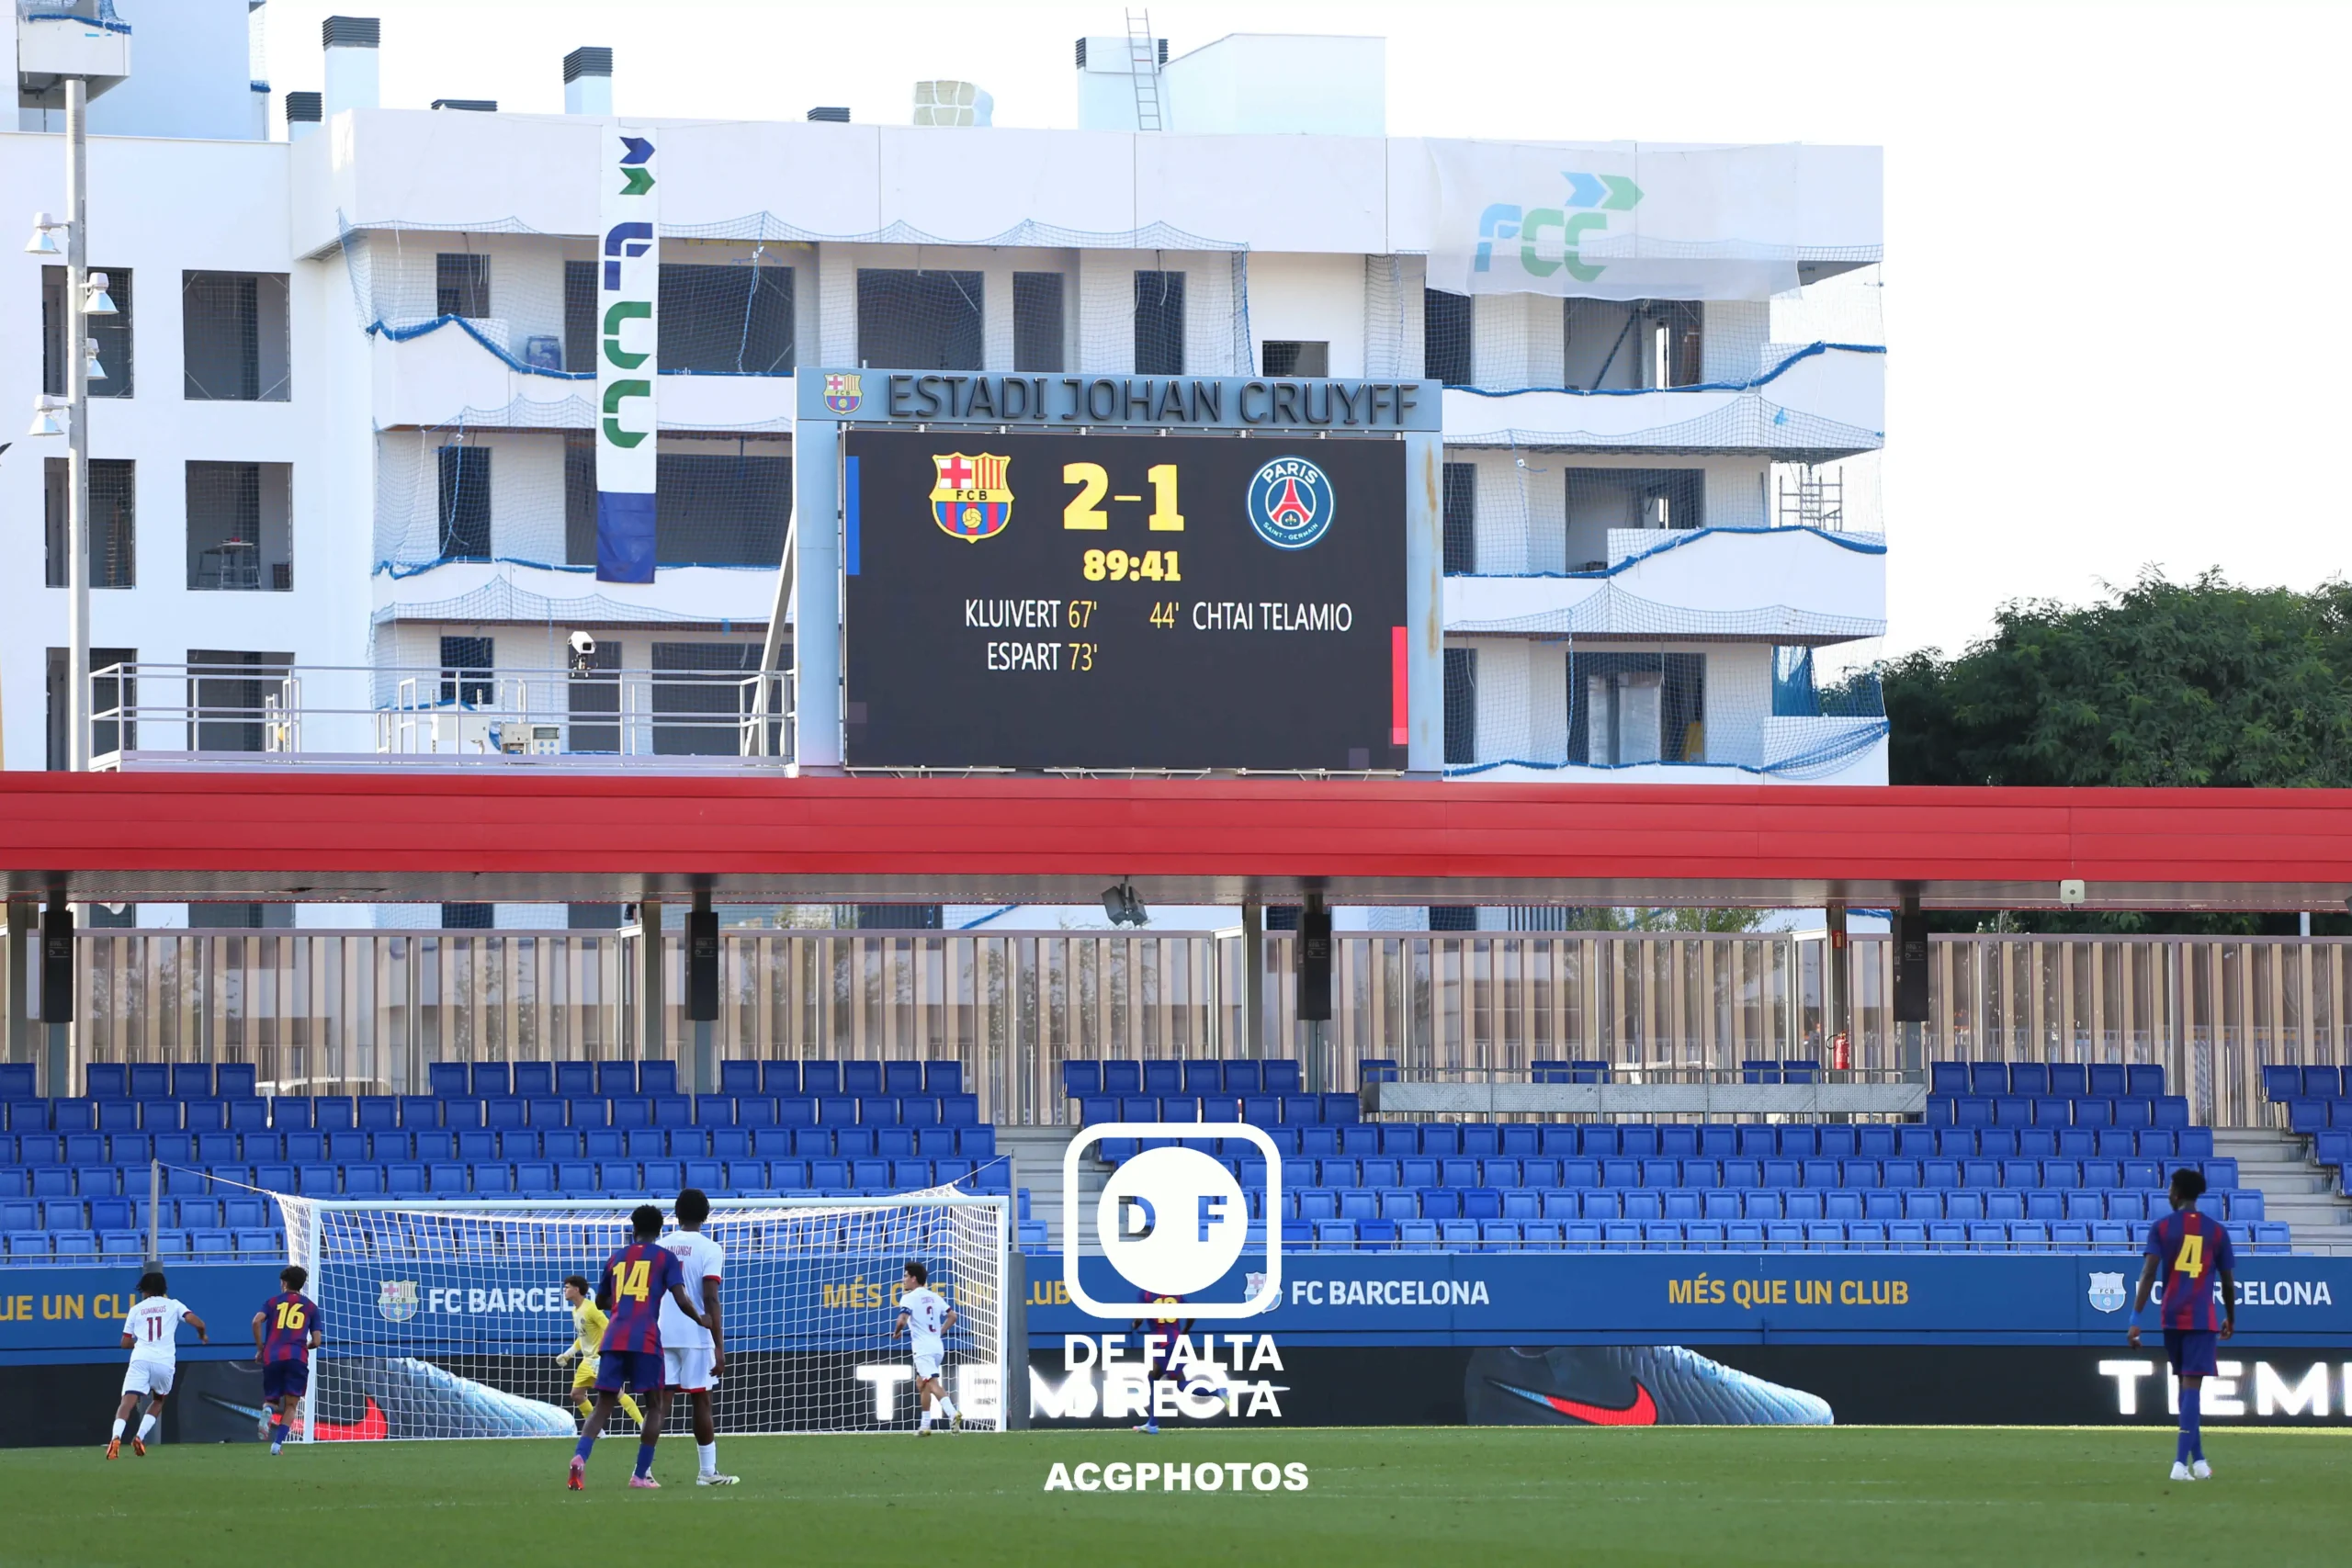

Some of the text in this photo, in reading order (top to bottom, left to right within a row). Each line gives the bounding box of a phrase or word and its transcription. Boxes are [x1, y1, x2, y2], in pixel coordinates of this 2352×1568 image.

[1474, 203, 1608, 283] FCC
[603, 221, 654, 449] FCC
[888, 375, 1419, 424] ESTADI JOHAN CRUYFF
[1261, 462, 1318, 484] PARIS
[956, 490, 989, 501] FCB
[1083, 549, 1182, 581] 89:41
[966, 600, 1097, 628] KLUIVERT 67'
[1149, 602, 1352, 631] 44' CHTAI TELAMIO
[988, 642, 1098, 671] ESPART 73'
[2174, 1234, 2203, 1278] 4
[613, 1260, 650, 1303] 14
[823, 1276, 883, 1308] MÉS
[1292, 1280, 1490, 1305] FC BARCELONA
[1668, 1272, 1909, 1309] MÉS QUE UN CLUB
[42, 1294, 85, 1320] UN
[94, 1293, 137, 1319] CL
[429, 1288, 462, 1313] FC
[147, 1316, 162, 1342] 11
[277, 1302, 305, 1329] 16
[2098, 1359, 2352, 1416] TIEM
